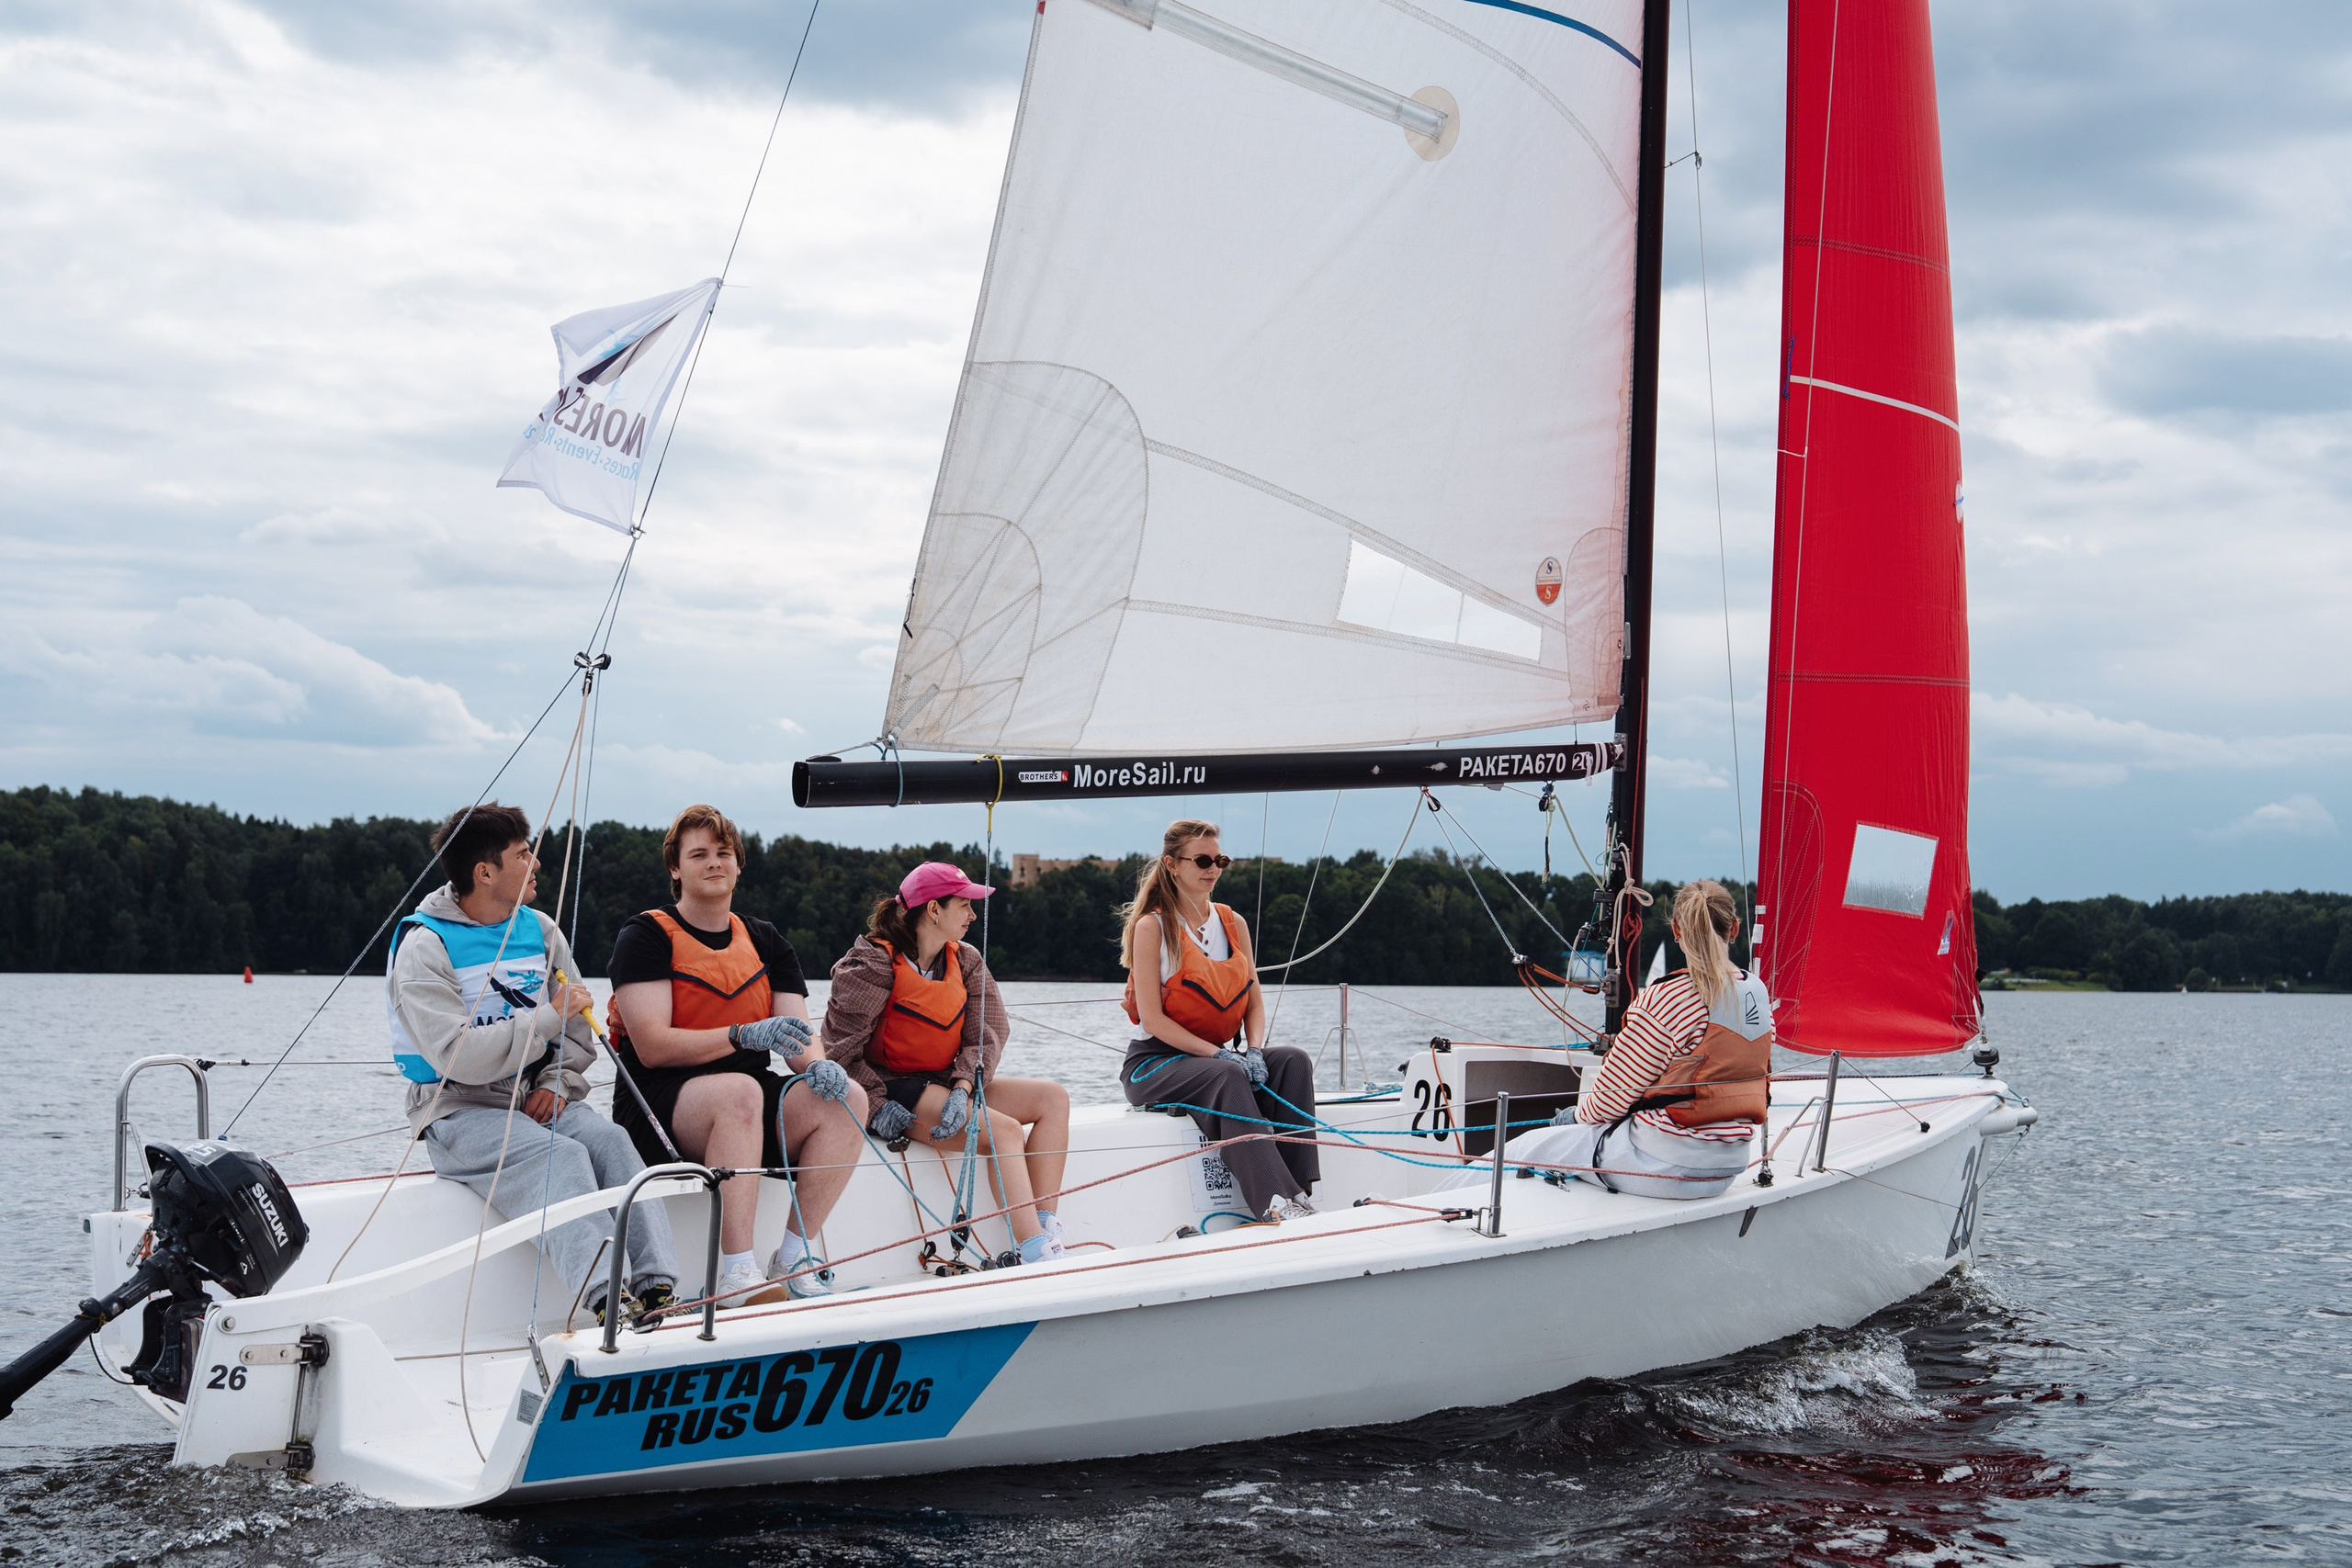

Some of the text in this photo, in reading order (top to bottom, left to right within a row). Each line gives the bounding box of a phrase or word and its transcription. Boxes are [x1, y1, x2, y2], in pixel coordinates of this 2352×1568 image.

[1073, 761, 1206, 788] MoreSail.ru
[1411, 1079, 1452, 1142] 26
[252, 1182, 289, 1248] SUZUKI
[207, 1364, 248, 1391] 26
[752, 1341, 901, 1433] 670
[884, 1377, 933, 1416] 26
[640, 1402, 751, 1450] RUS
